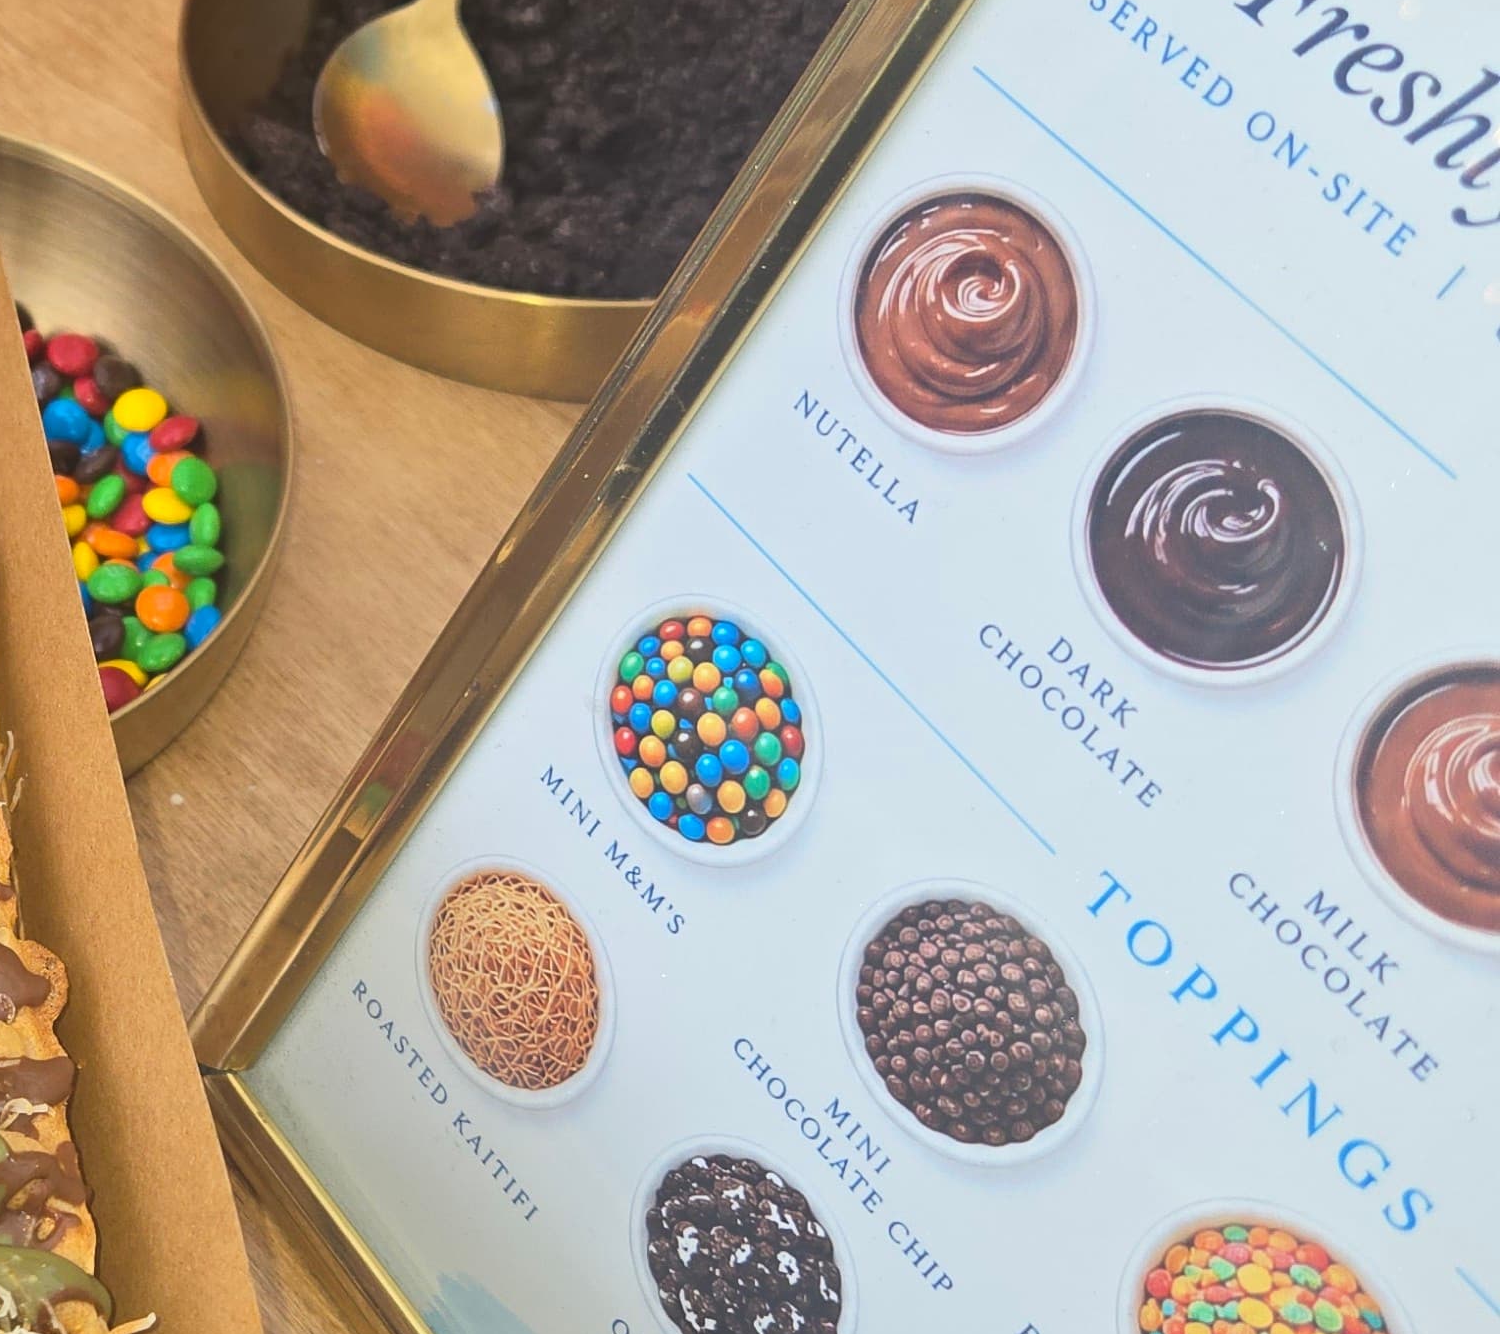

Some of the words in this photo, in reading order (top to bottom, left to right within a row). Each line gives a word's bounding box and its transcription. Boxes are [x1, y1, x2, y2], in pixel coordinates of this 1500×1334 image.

[1245, 110, 1417, 258] ON-SITE
[793, 389, 919, 525] NUTELLA
[979, 623, 1163, 809] CHOCOLATE
[1046, 635, 1138, 729] DARK
[539, 763, 602, 838] MINI
[603, 839, 686, 935] M&M'S
[1228, 872, 1439, 1083] CHOCOLATE
[1303, 889, 1400, 986] MILK
[351, 979, 448, 1105] ROASTED
[451, 1110, 539, 1222] KAITIFI
[823, 1096, 892, 1175] MINI
[1085, 869, 1435, 1234] TOPPINGS
[733, 1037, 884, 1215] CHOCOLATE
[887, 1220, 954, 1291] CHIP
